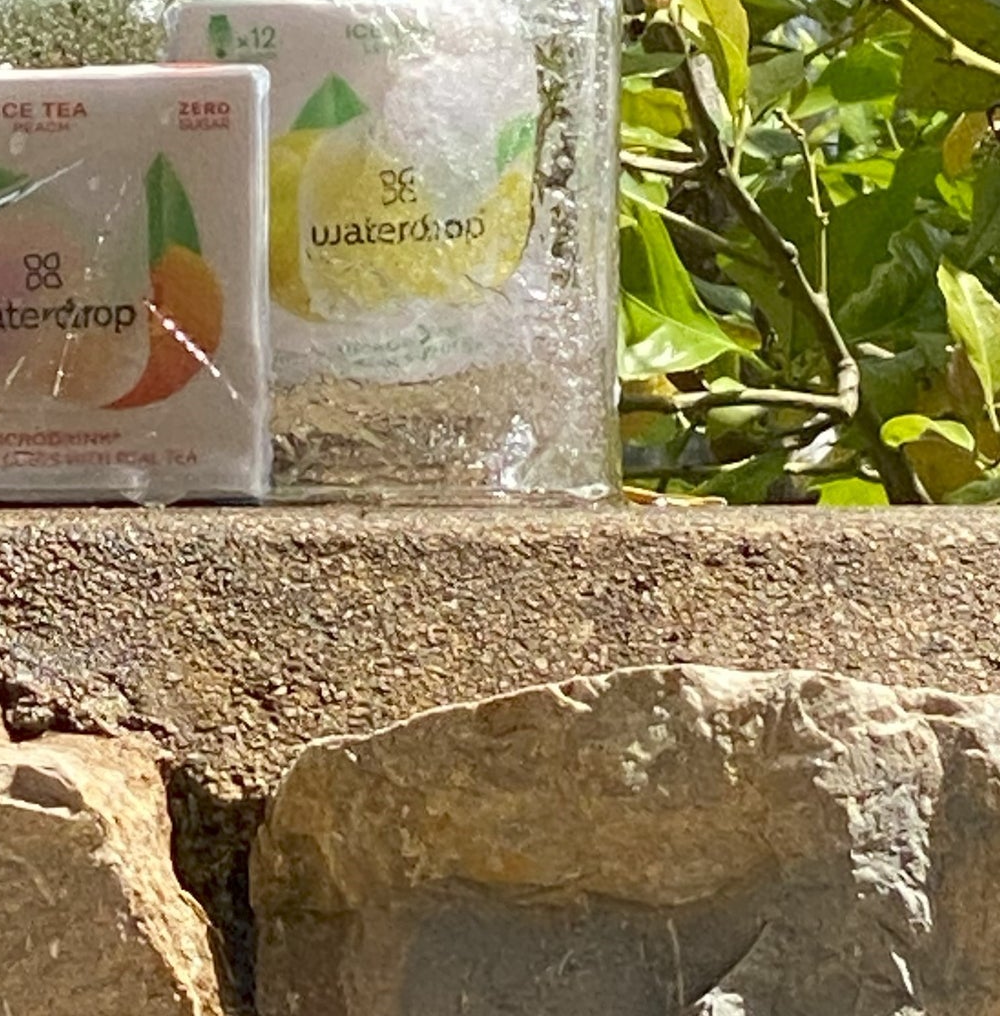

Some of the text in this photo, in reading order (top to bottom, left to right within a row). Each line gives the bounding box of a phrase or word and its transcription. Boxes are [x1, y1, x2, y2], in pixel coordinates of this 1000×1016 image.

[237, 26, 277, 49] x12
[42, 101, 88, 119] TEA
[178, 101, 230, 116] ZERO
[12, 121, 70, 134] PEACH
[179, 117, 230, 131] SUGAR
